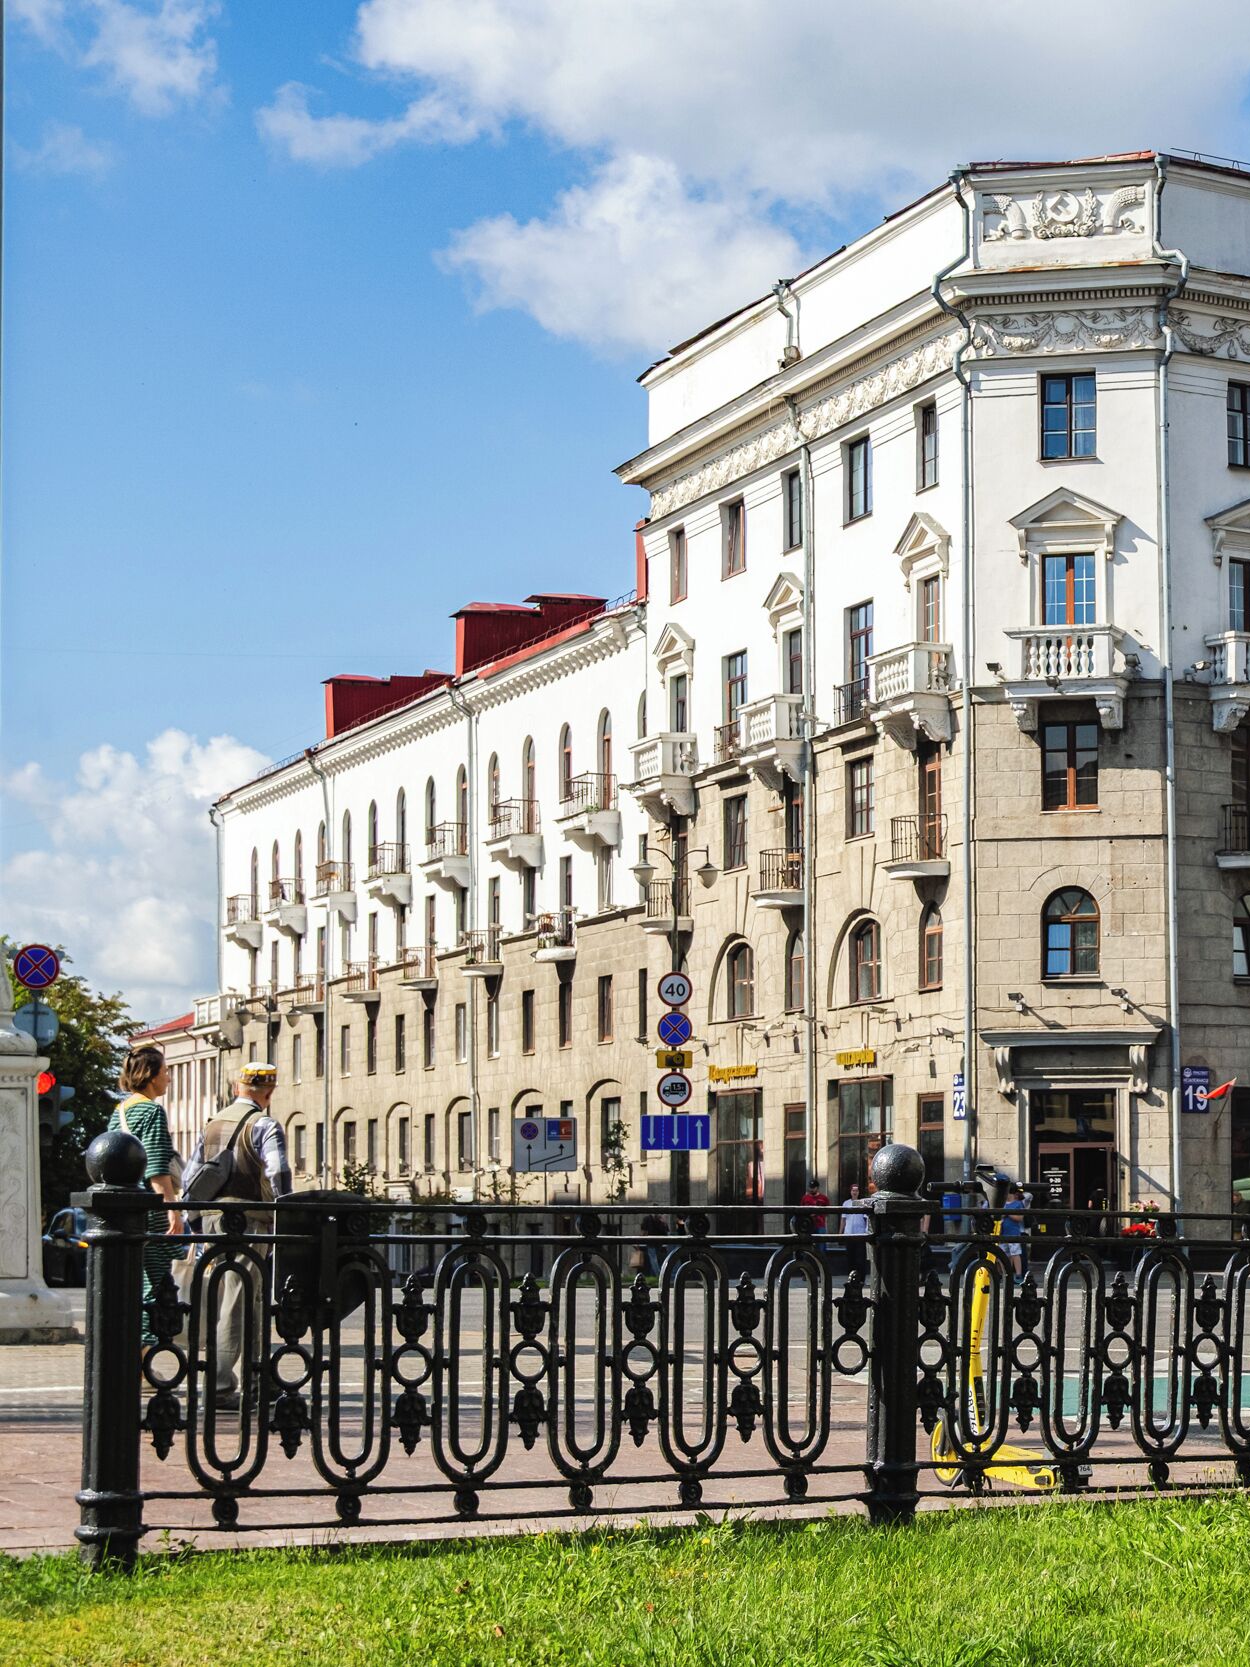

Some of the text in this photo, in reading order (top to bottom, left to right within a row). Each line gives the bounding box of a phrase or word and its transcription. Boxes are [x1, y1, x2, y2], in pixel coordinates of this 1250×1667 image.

[665, 983, 685, 996] 40
[953, 1091, 966, 1117] 23
[1185, 1085, 1208, 1110] 19
